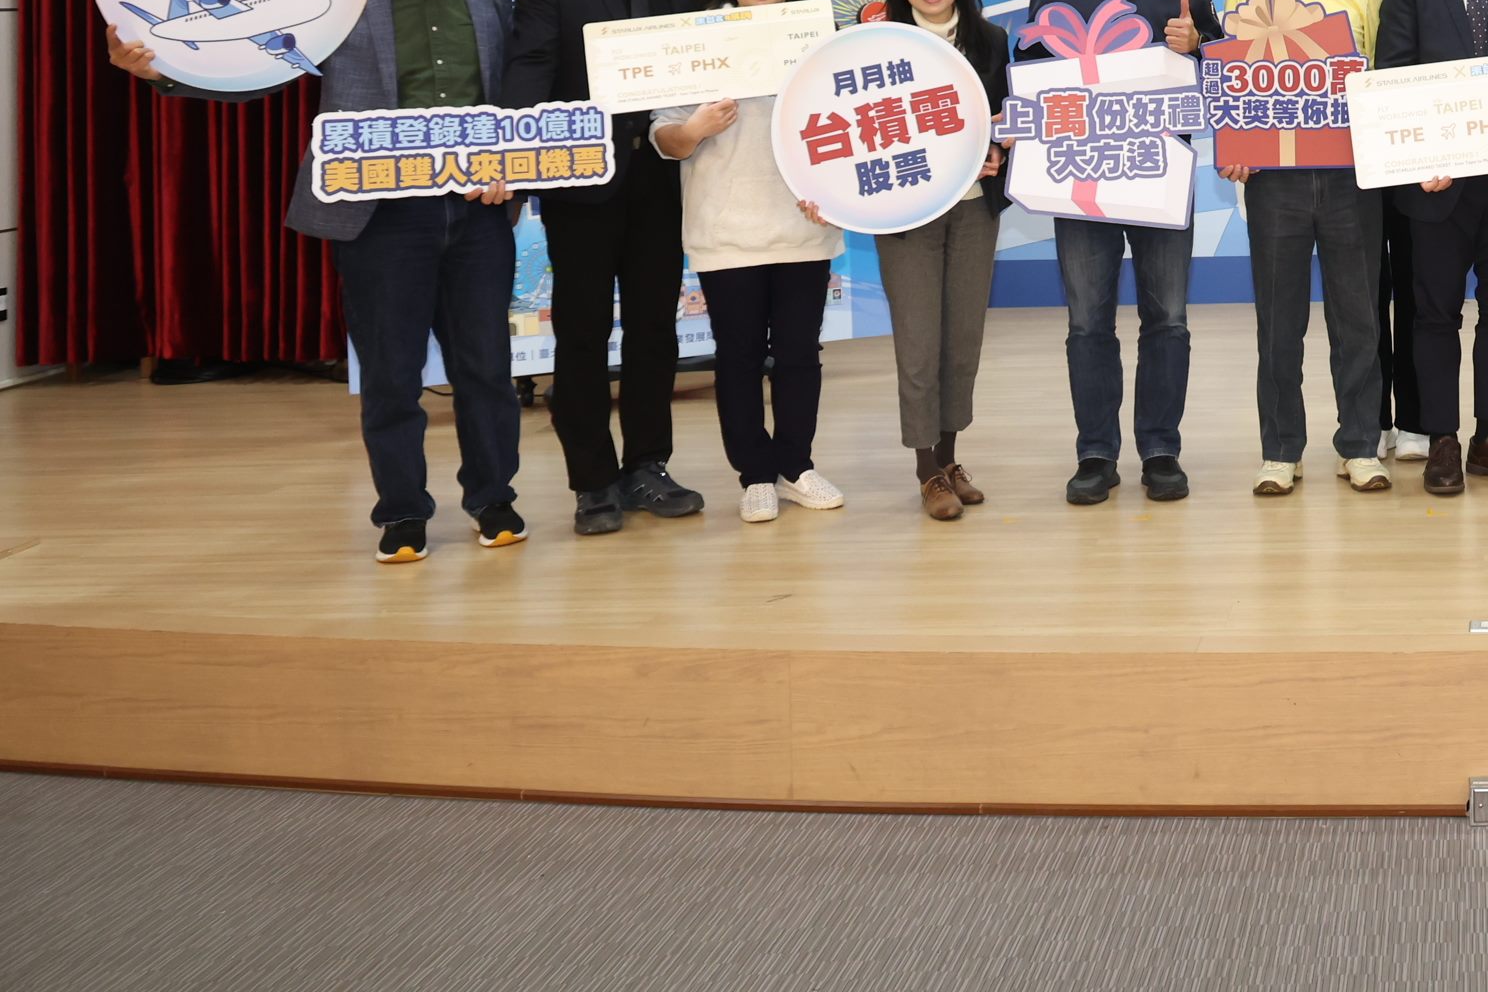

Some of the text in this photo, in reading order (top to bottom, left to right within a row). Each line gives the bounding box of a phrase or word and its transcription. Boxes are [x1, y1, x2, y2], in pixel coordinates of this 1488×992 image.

[662, 44, 706, 56] TAIPEI
[788, 31, 819, 40] TAIPEI
[618, 57, 730, 80] TPE PHX
[833, 58, 914, 97] 月月抽
[1204, 62, 1221, 95] 超過
[799, 84, 966, 166] 台積電
[996, 91, 1203, 139] 上萬份好禮
[1434, 98, 1483, 115] TAIPEI
[321, 107, 604, 153] 累積登錄達10億抽
[1385, 127, 1424, 145] TPE
[321, 146, 607, 194] 美國雙人來回機票
[854, 148, 932, 197] 股票
[1051, 141, 1165, 178] 大方送
